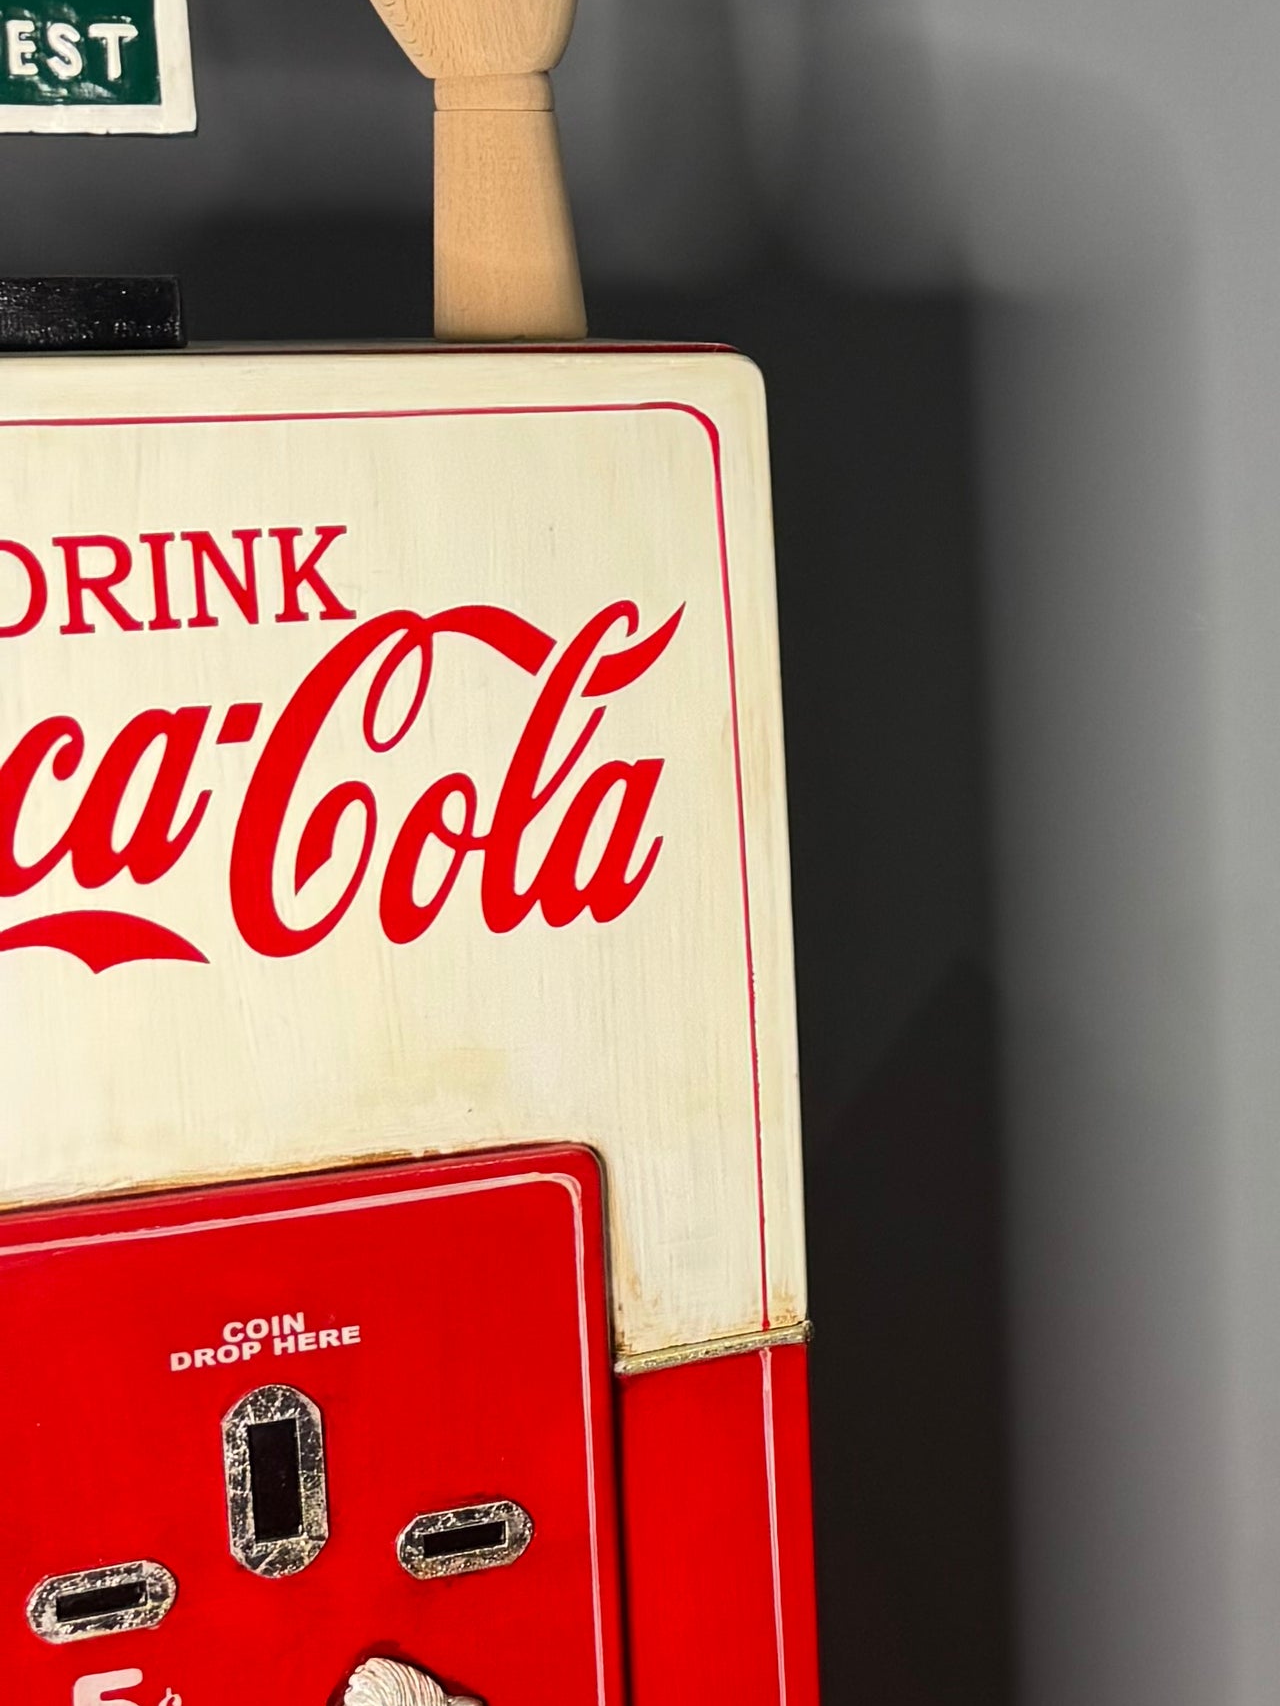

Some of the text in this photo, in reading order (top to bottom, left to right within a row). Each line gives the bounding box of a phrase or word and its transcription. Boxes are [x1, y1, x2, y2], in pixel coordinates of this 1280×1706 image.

[222, 1312, 304, 1343] COIN
[170, 1325, 361, 1372] DROP HERE
